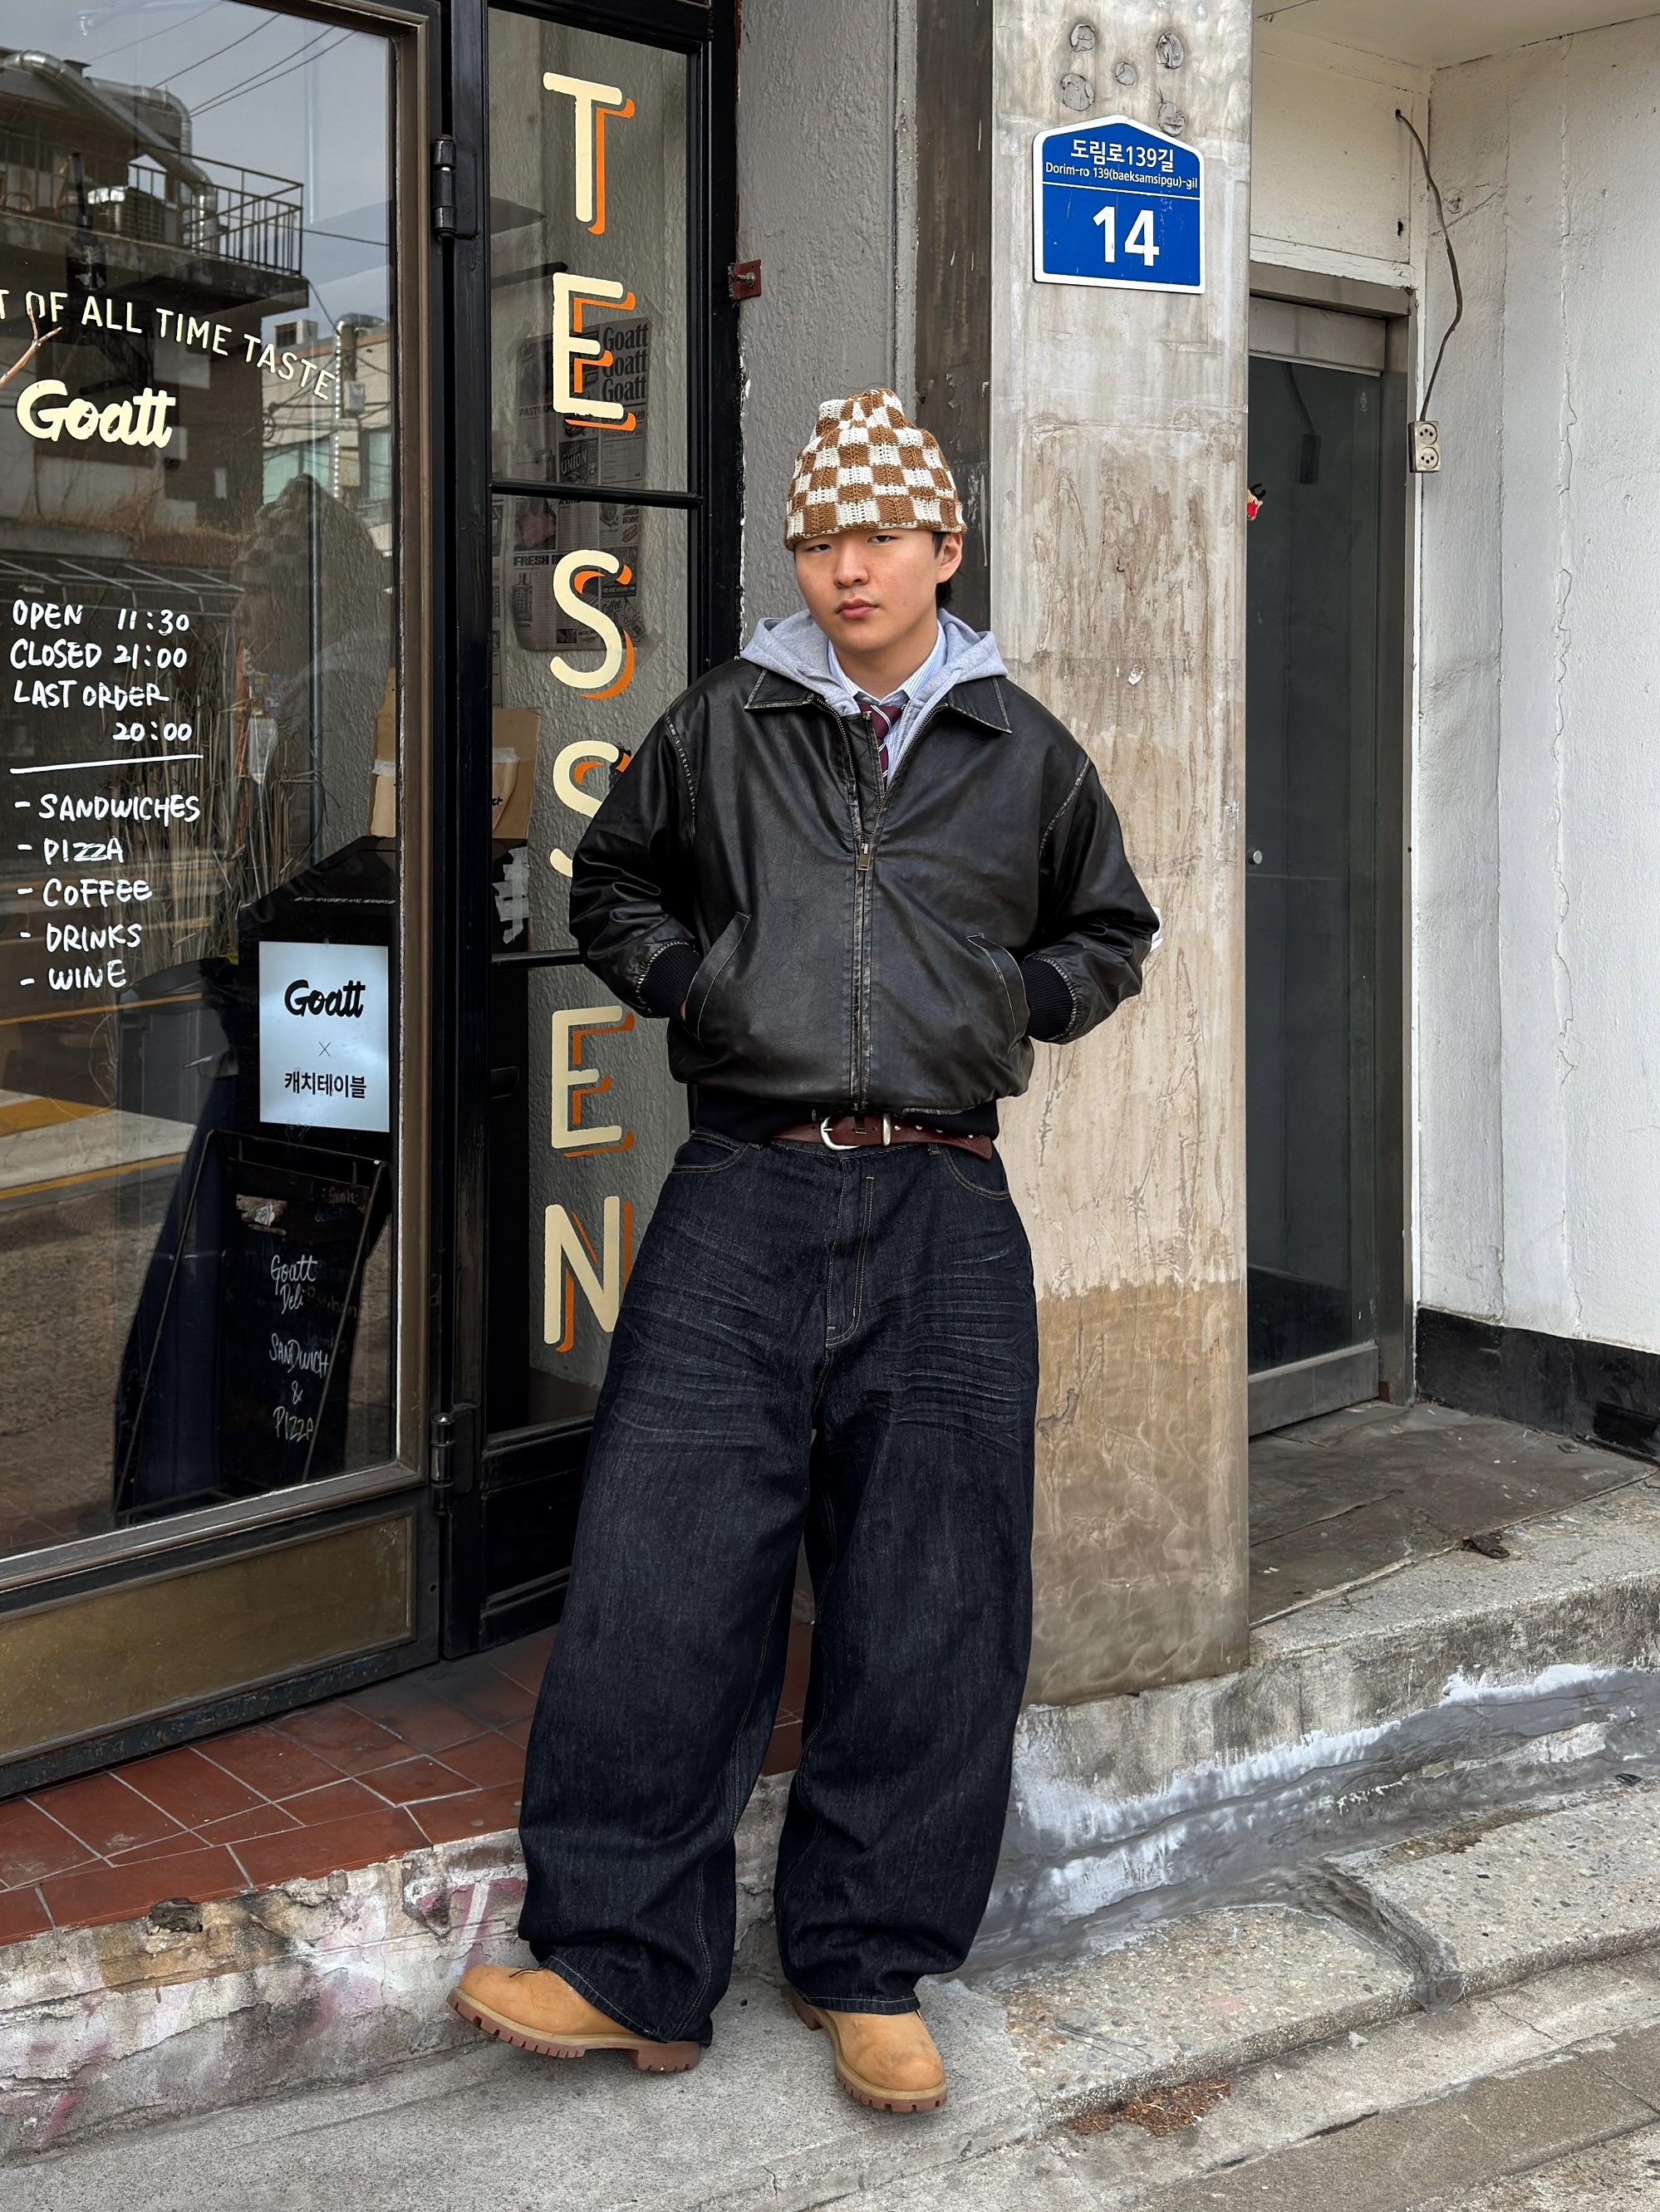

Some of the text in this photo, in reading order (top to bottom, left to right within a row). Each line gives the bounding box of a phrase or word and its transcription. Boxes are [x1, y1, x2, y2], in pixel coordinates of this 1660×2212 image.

[1070, 139, 1174, 173] 도림로139길
[1045, 161, 1198, 190] Dorim-ro 139(baeksamsipgu)-gil
[1092, 205, 1160, 267] 14
[26, 292, 68, 322] OF
[81, 296, 142, 334] ALL
[155, 307, 233, 356] TIME
[243, 334, 336, 400] TASTE
[602, 323, 649, 351] Goatt
[17, 379, 176, 449] Goatt
[561, 449, 588, 474] UNION
[513, 555, 549, 566] FRESH
[12, 600, 189, 635] OPEN 11:30
[10, 639, 188, 670] CLOSED 21:00
[13, 679, 170, 711] LAST ORDER
[112, 721, 193, 742] 20:00
[38, 793, 201, 827] SANDWICHES
[43, 836, 124, 866] PIZZA
[43, 878, 153, 908] COFFEE
[46, 922, 143, 953] DRINKS
[48, 959, 127, 991] WINE
[284, 978, 366, 1019] Goatt
[284, 1071, 367, 1100] 캐치테이블
[270, 1253, 318, 1295] Goatt
[279, 1283, 305, 1316] Deli
[268, 1332, 329, 1379] SANDWICH
[291, 1380, 304, 1405] &
[273, 1405, 314, 1443] PIZZA
